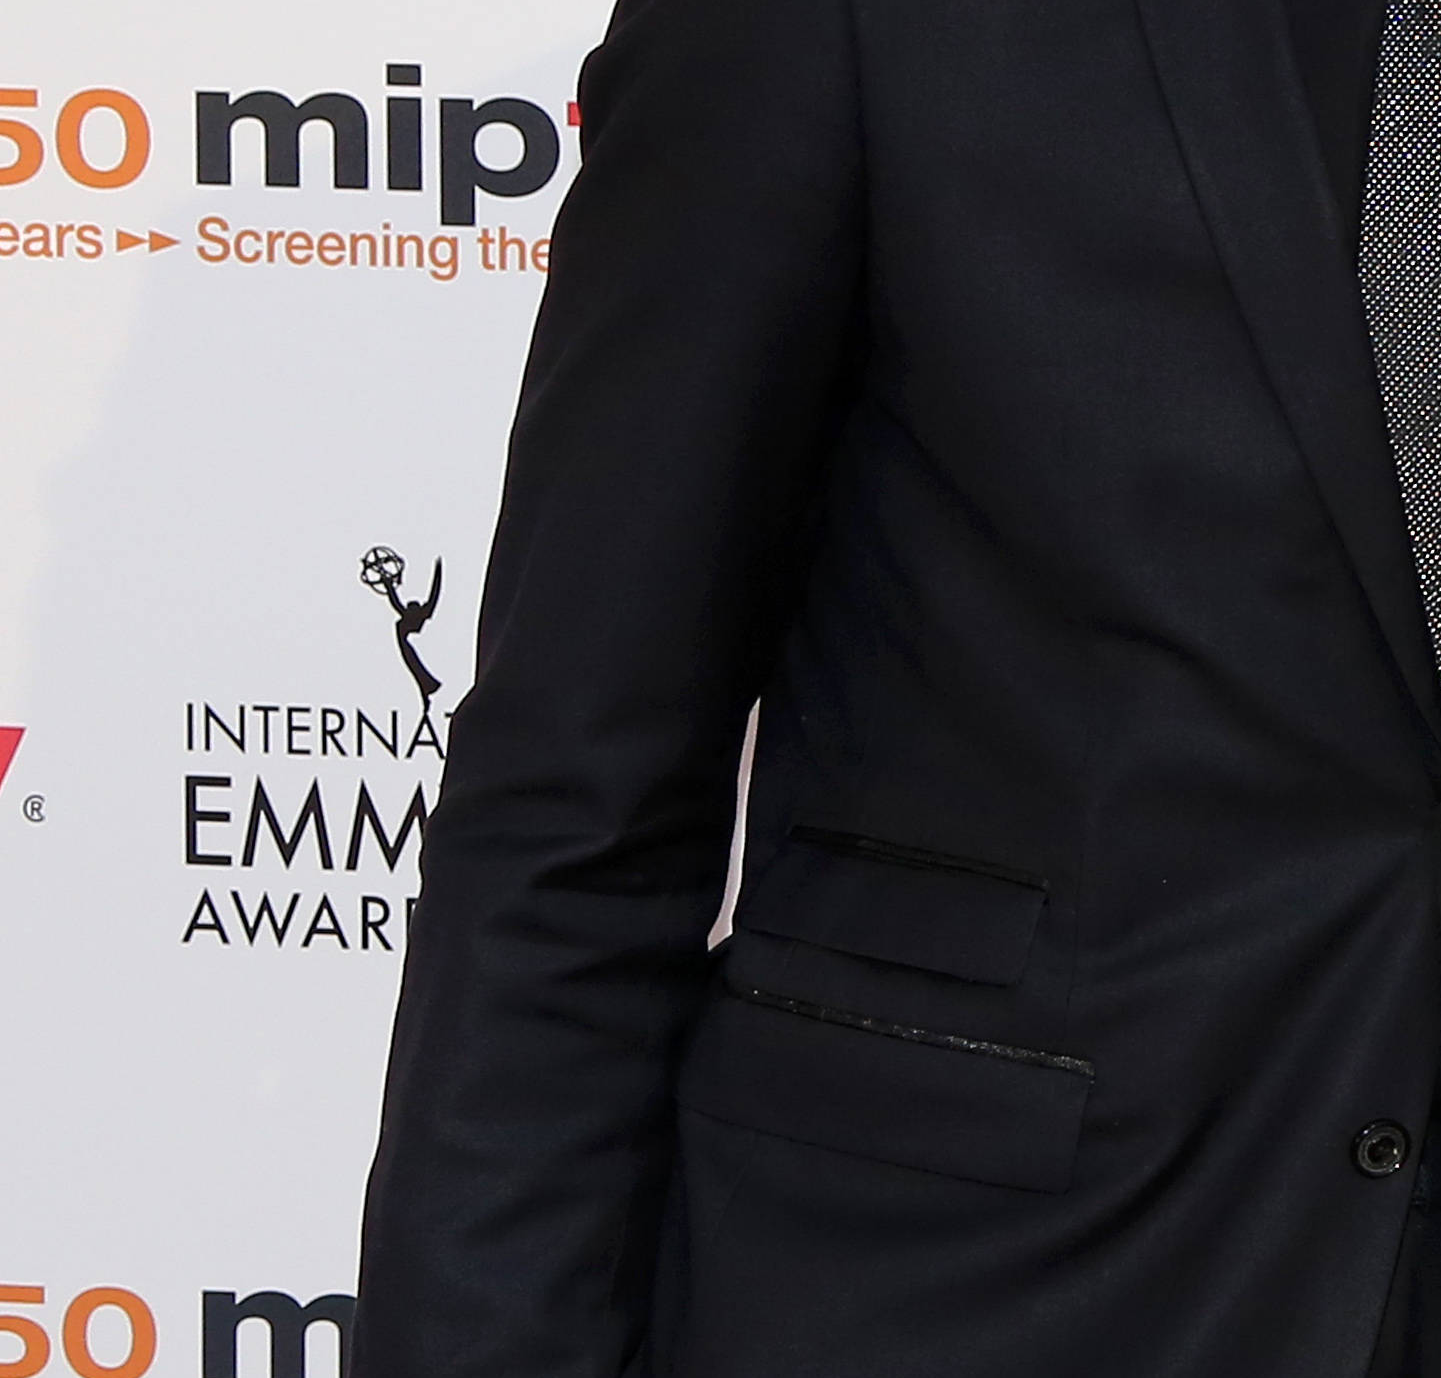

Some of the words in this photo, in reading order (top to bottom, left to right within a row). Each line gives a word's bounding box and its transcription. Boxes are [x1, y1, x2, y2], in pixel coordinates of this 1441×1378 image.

[195, 63, 581, 226] mip
[0, 222, 103, 260] ears
[197, 217, 459, 281] Screening
[476, 226, 551, 273] the
[187, 703, 453, 759] INTERNA
[185, 775, 427, 872] EMM
[182, 888, 418, 951] AWAR
